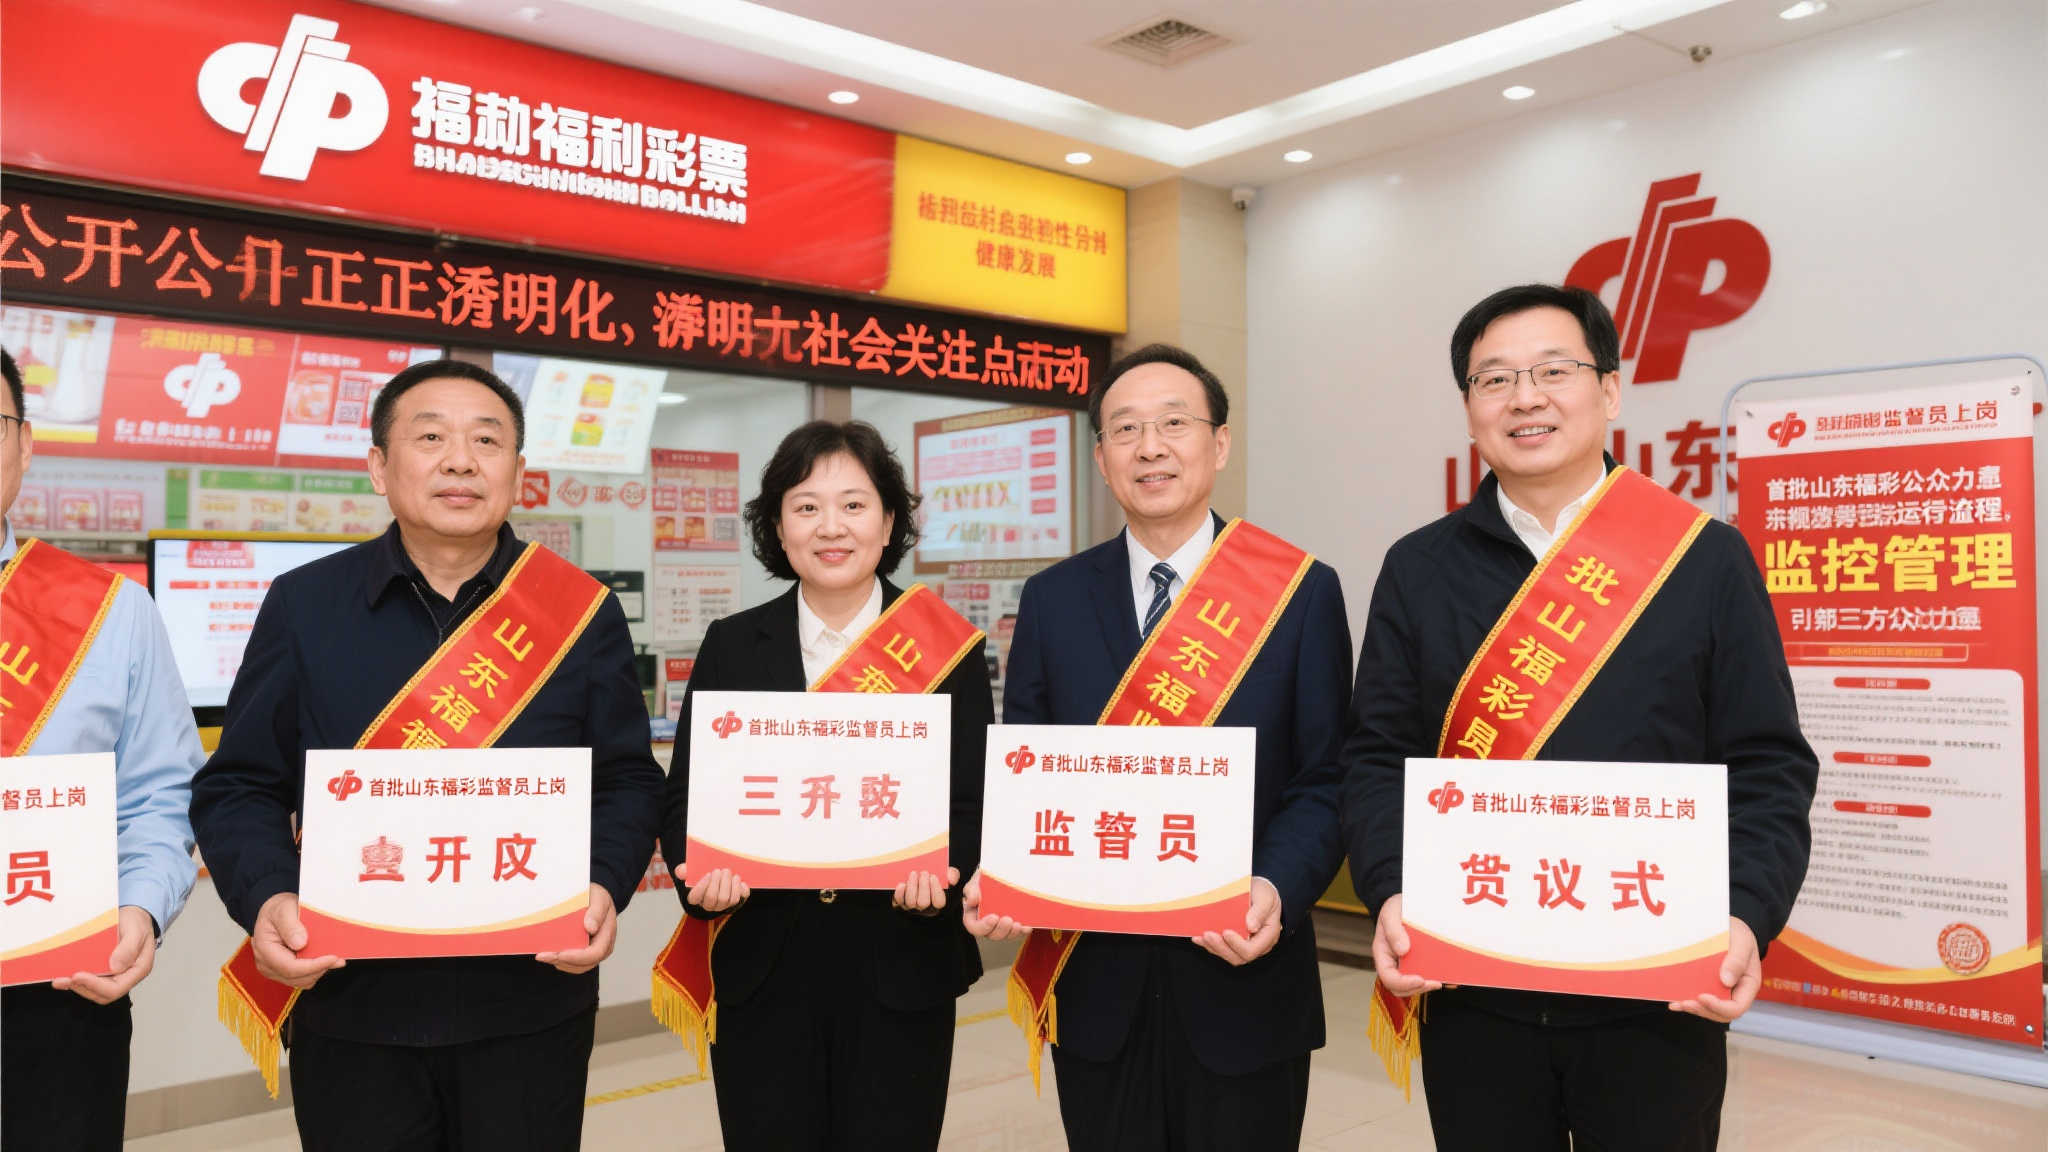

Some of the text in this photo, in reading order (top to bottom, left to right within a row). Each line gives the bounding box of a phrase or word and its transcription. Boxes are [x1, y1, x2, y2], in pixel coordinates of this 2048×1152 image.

[976, 239, 1057, 280] 健康发展
[1765, 532, 2017, 594] 监控管理
[747, 717, 929, 740] 首批山东福彩监督员上岗
[1040, 753, 1230, 777] 首批山东福彩监督员上岗
[369, 776, 567, 798] 首批山东福彩监督员上岗
[1471, 791, 1696, 820] 首批山东福彩监督员上岗
[1029, 809, 1199, 863] 监督员
[4, 851, 55, 906] 员
